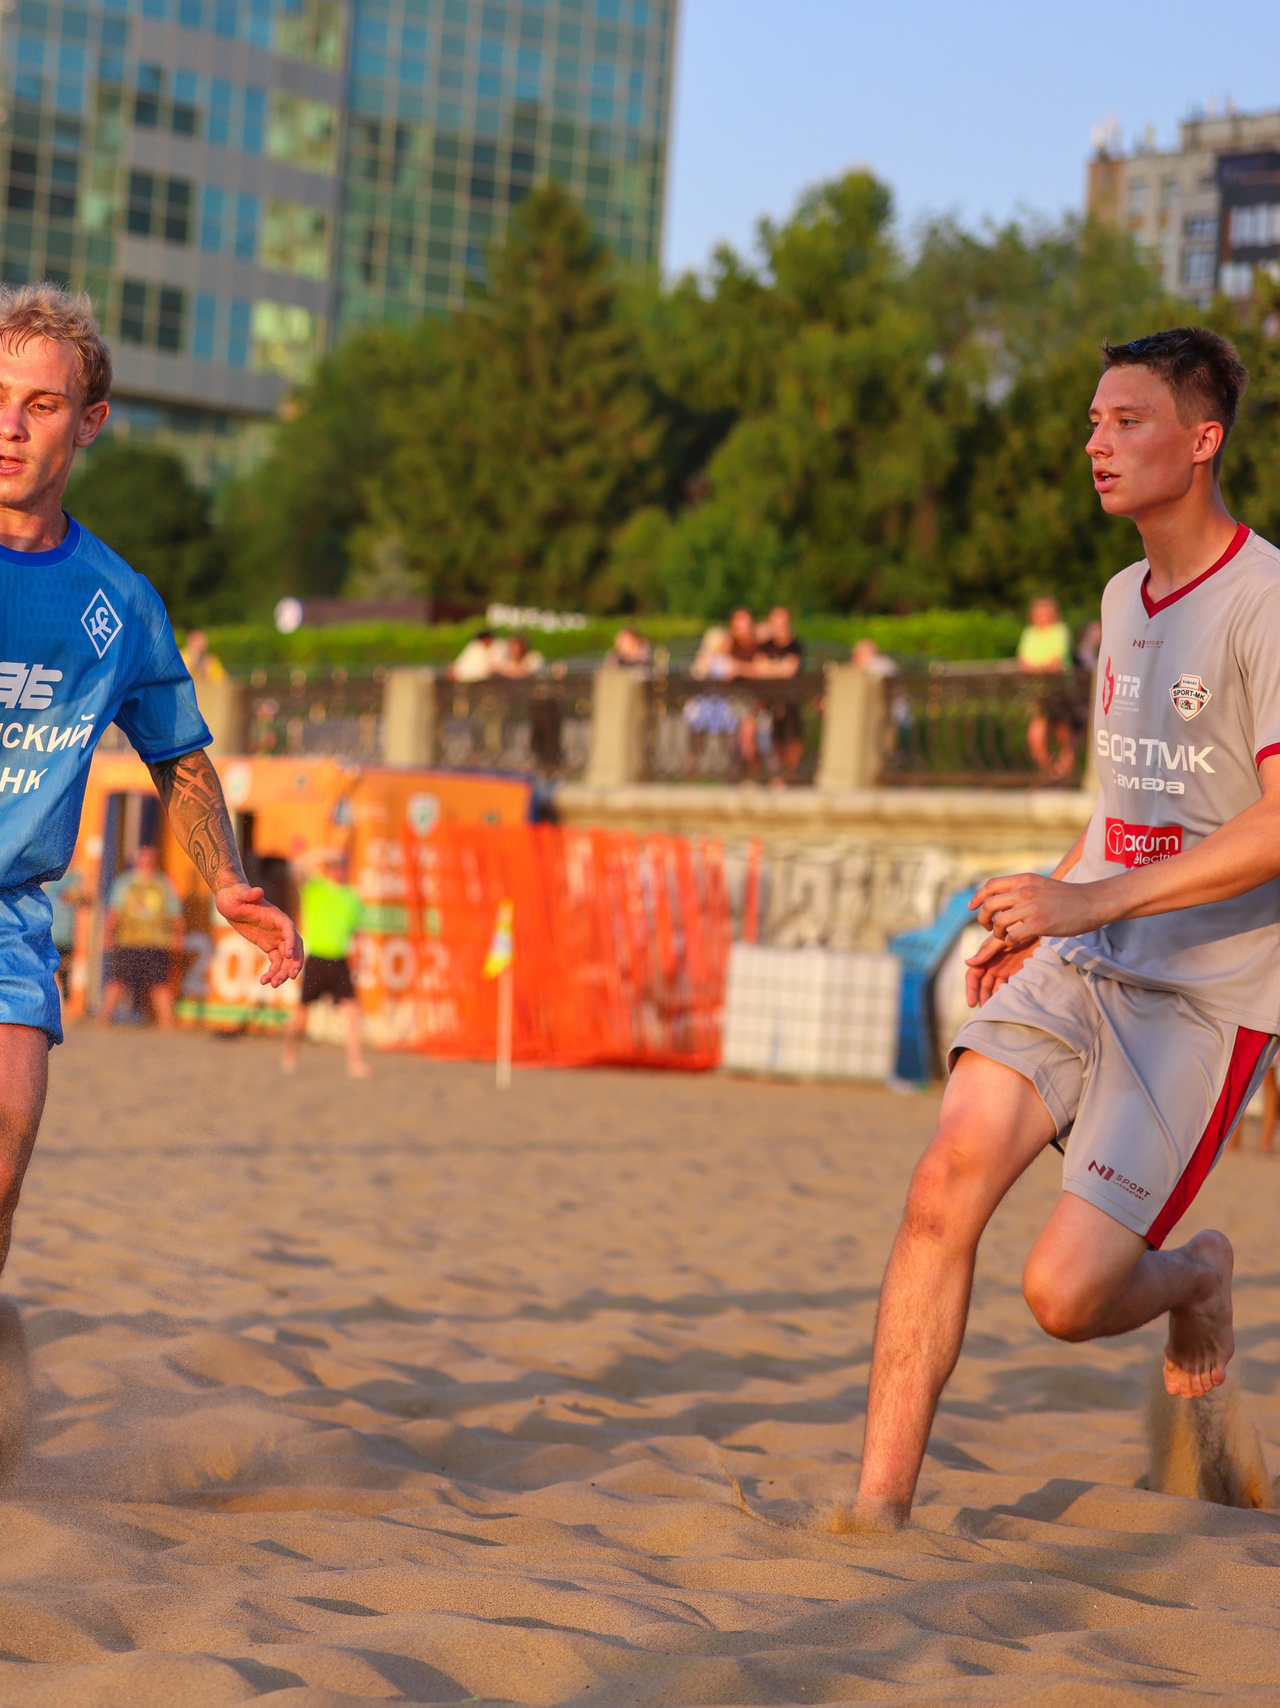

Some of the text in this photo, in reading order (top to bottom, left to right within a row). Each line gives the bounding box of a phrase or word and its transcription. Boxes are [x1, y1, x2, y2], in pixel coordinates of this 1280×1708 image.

[1173, 689, 1205, 701] SPORT-MK
[1113, 1180, 1145, 1201] LABORATORY
[1116, 1174, 1151, 1198] SPORT
